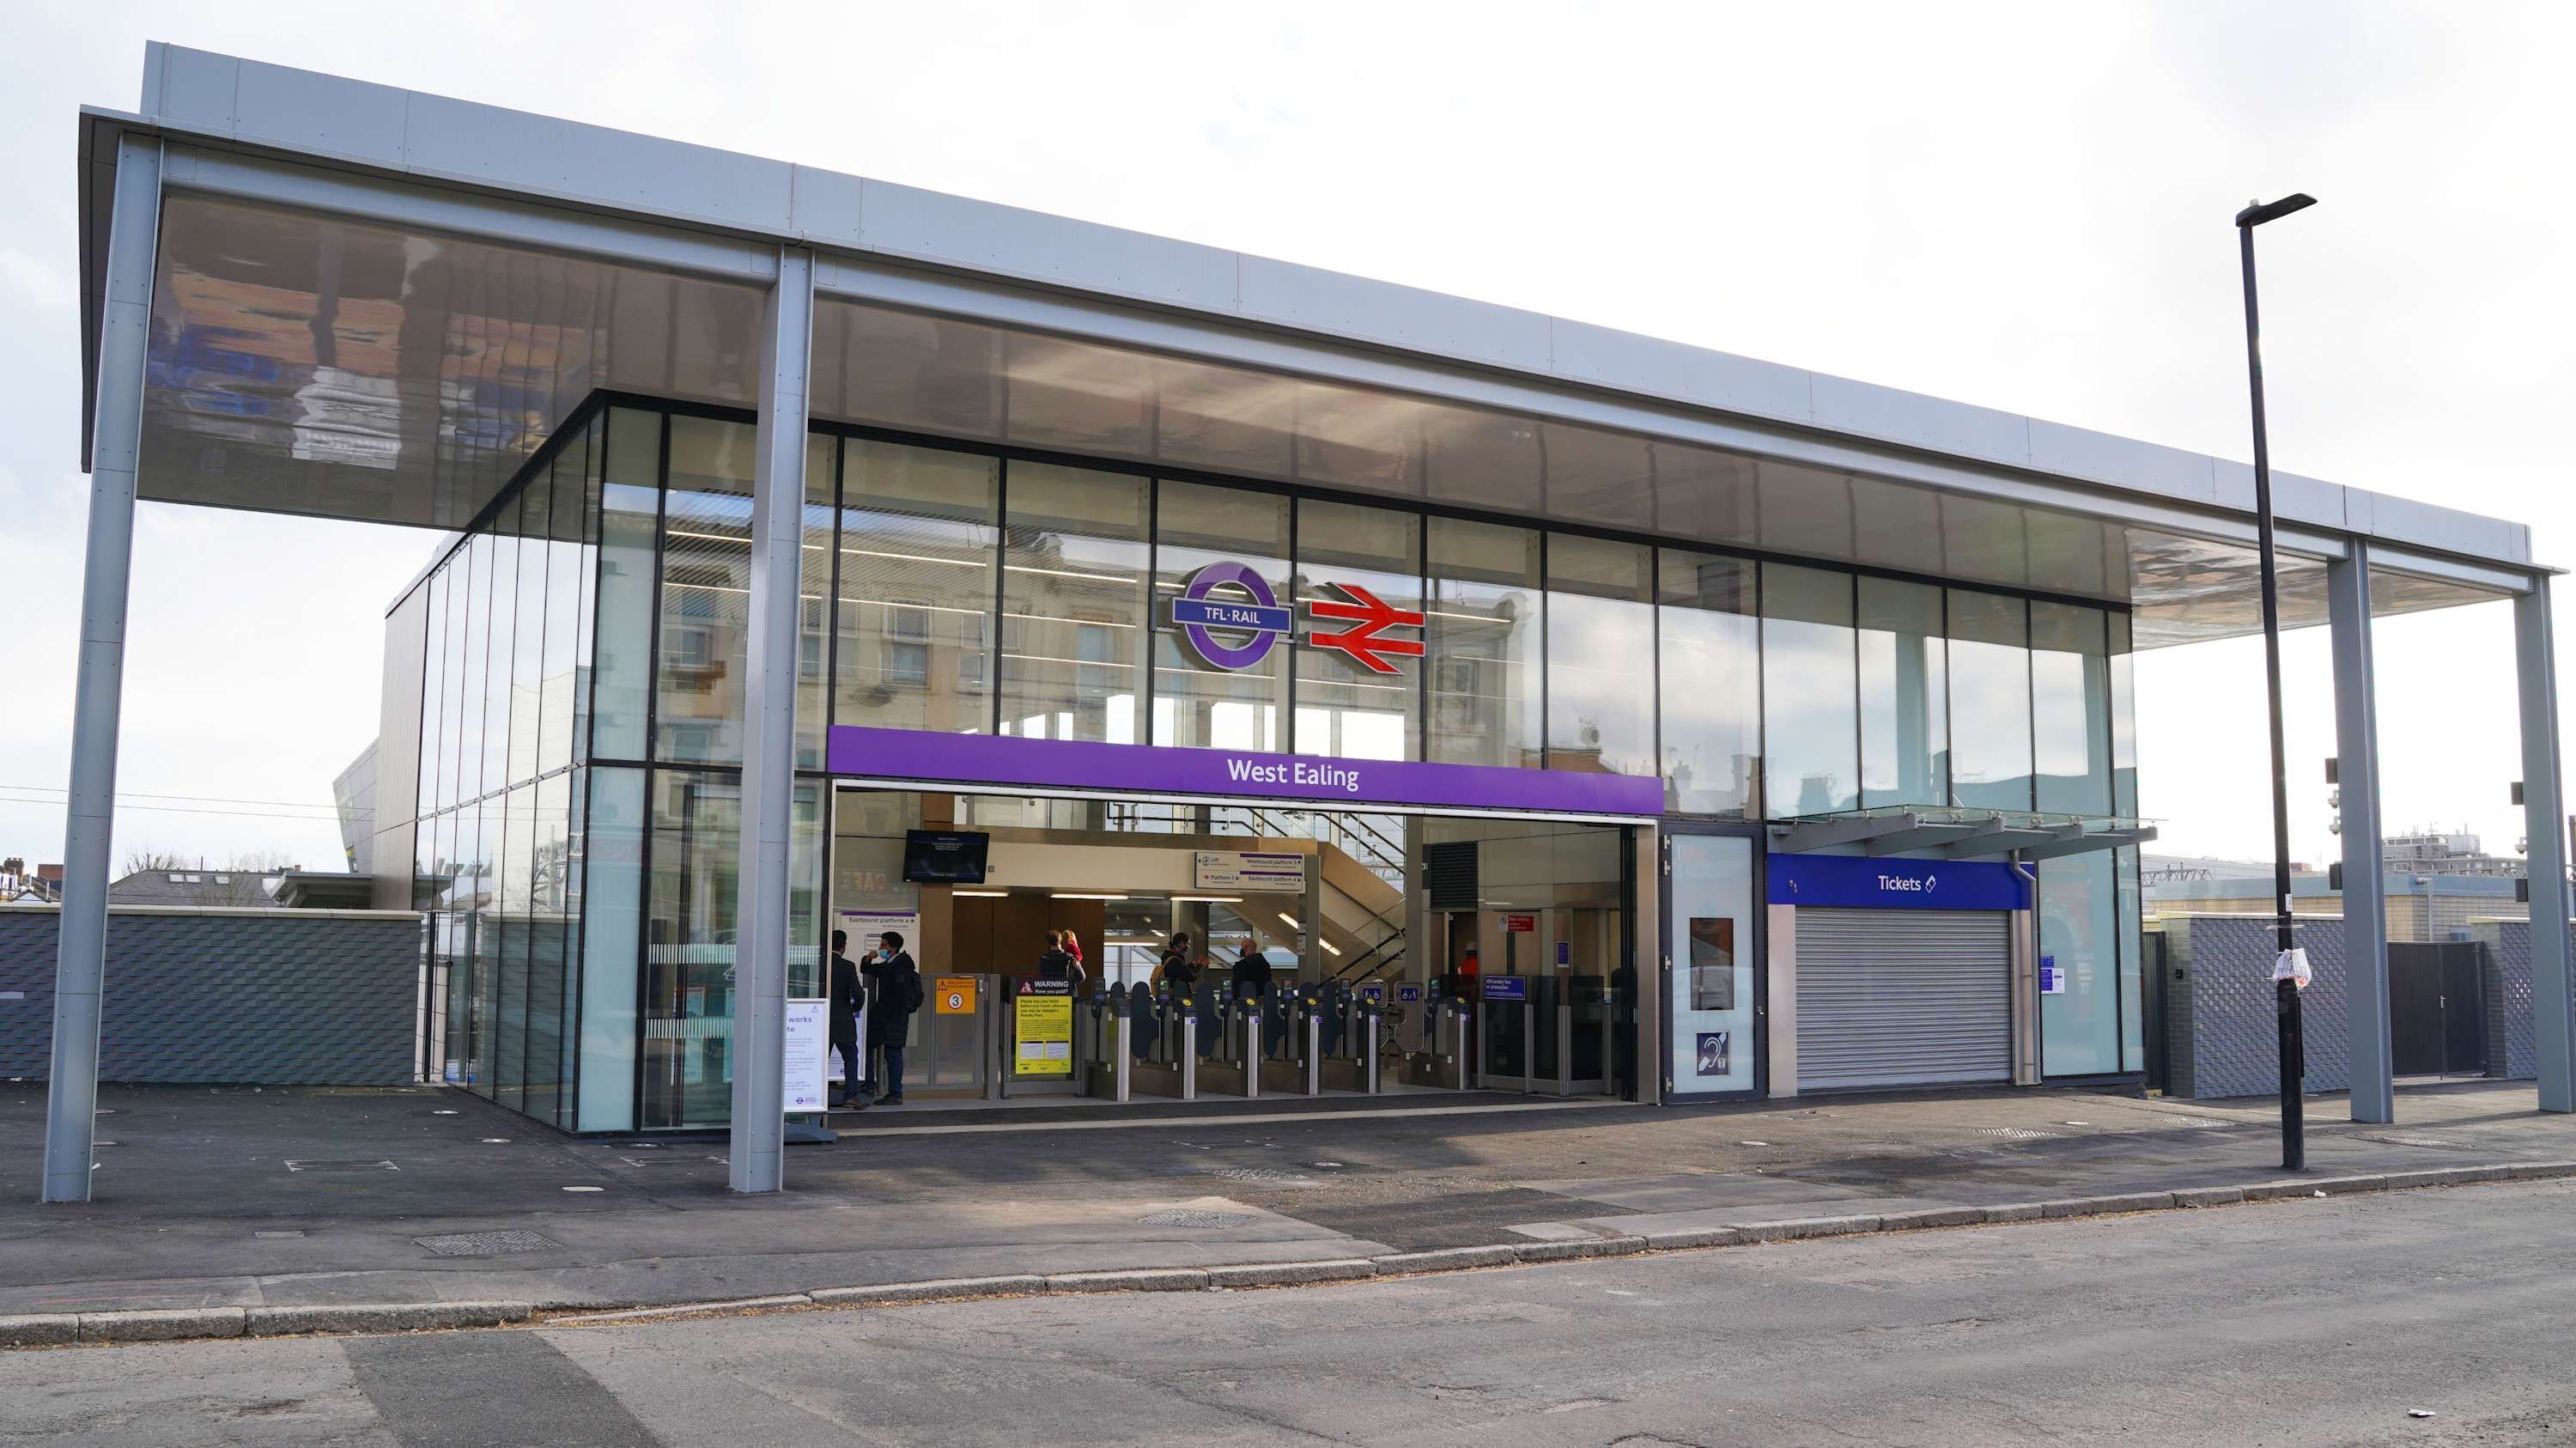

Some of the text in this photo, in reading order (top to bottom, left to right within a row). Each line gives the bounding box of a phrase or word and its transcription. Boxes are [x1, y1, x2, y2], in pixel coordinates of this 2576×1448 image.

[1227, 758, 1359, 792] West Ealing
[1878, 875, 1922, 891] Tickets
[952, 995, 959, 1007] 3
